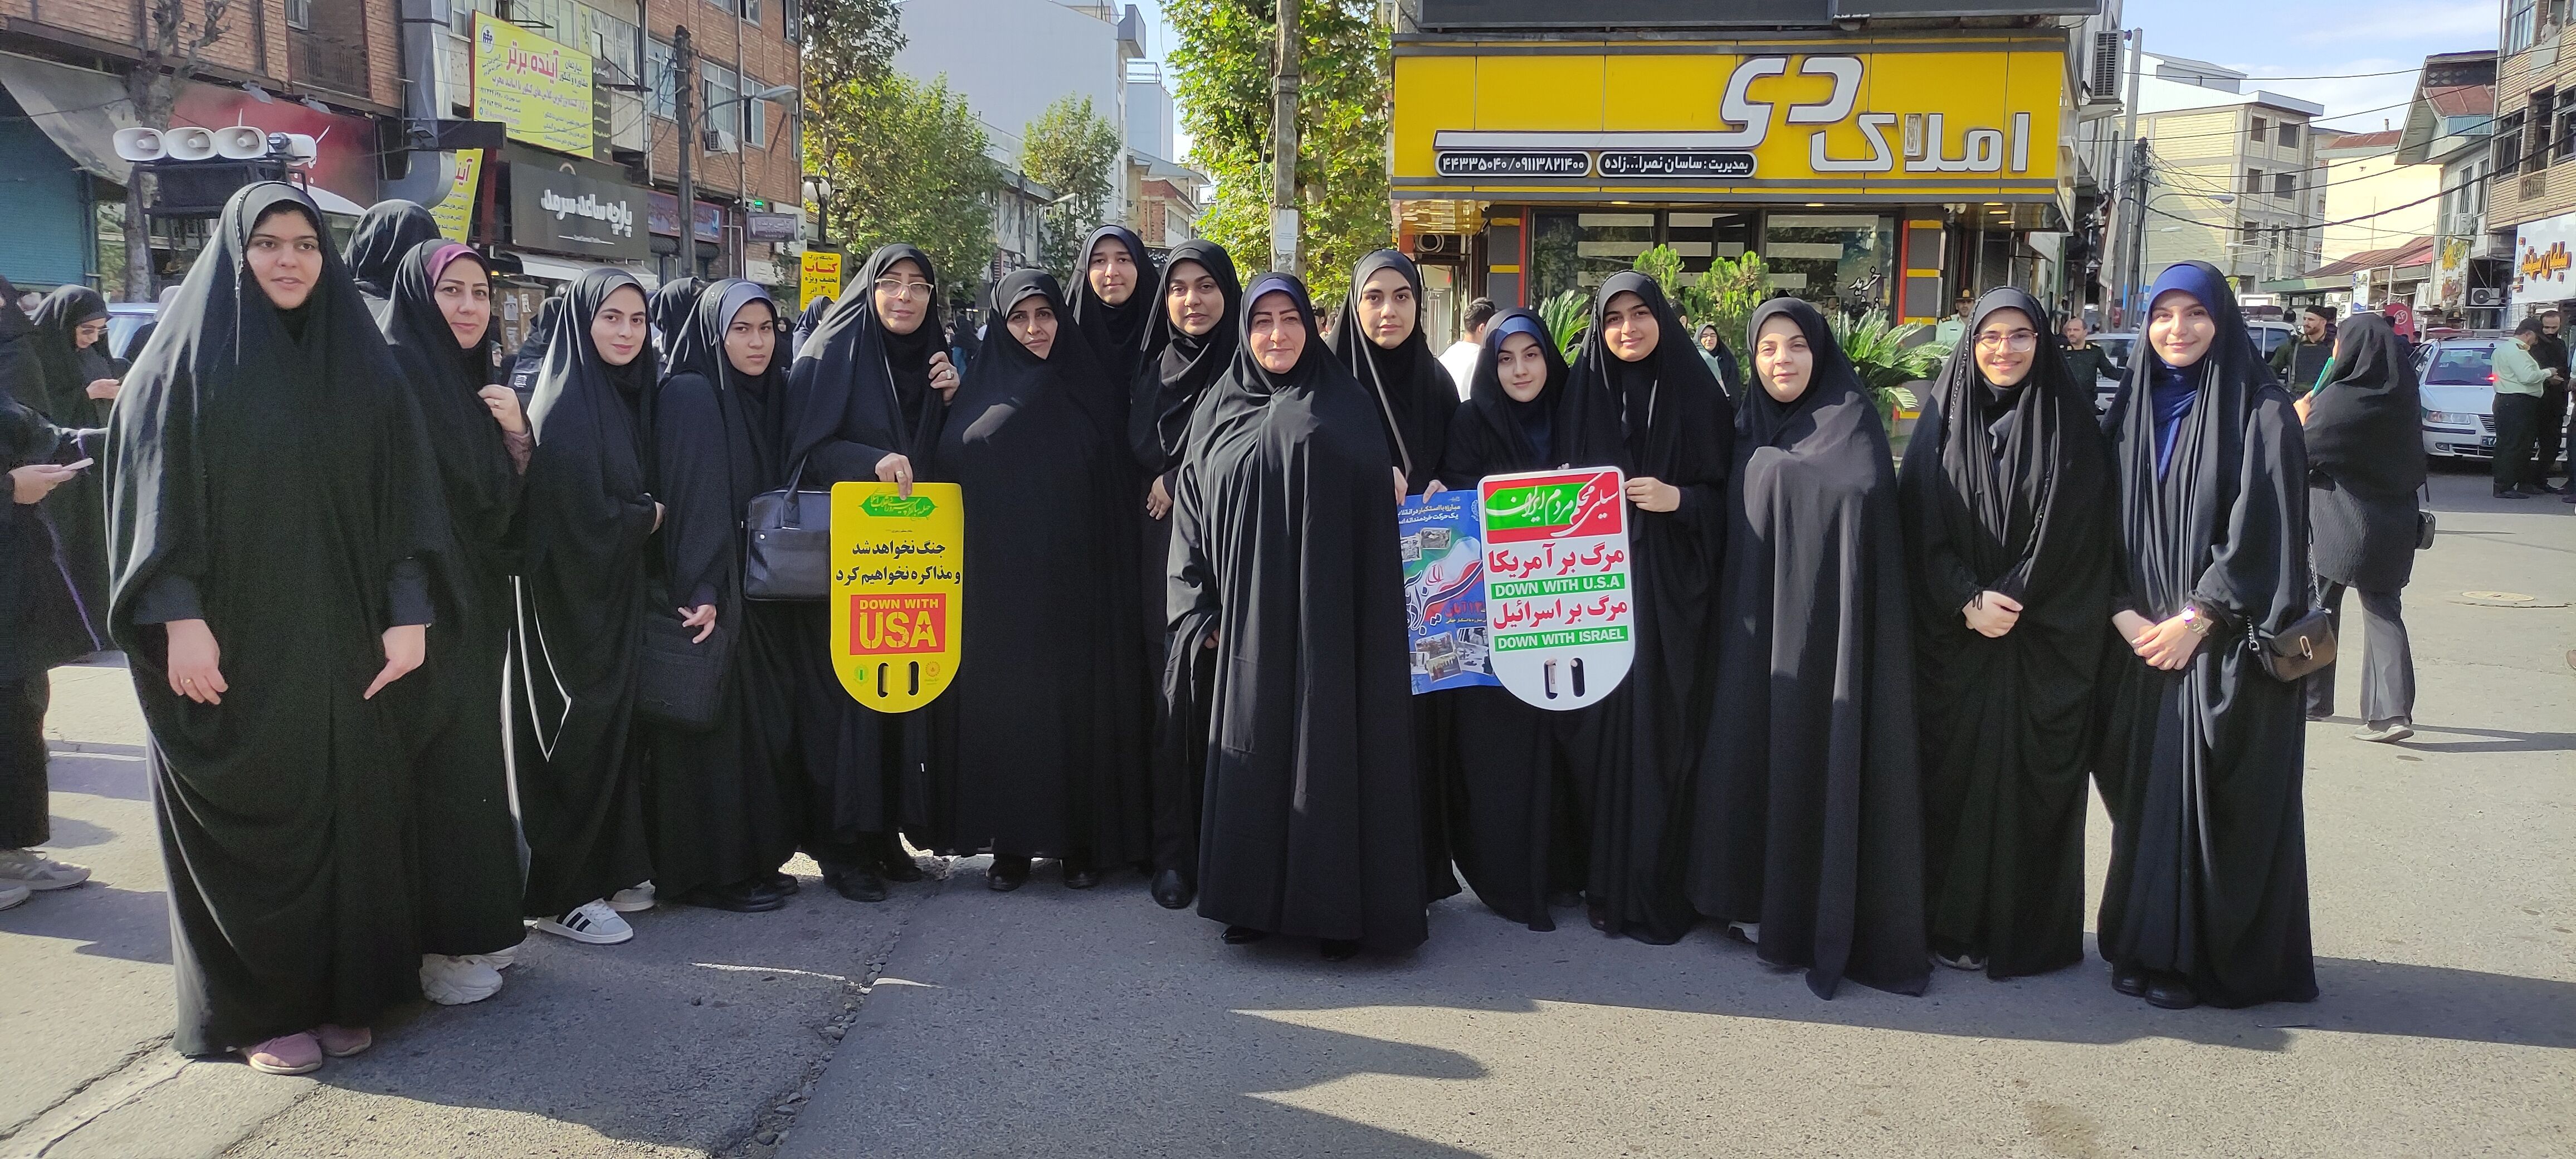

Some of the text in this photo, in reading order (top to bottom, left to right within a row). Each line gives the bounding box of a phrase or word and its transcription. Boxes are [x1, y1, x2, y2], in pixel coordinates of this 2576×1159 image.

[506, 41, 527, 75] برتر
[531, 50, 559, 84] آینده
[1433, 55, 1864, 150] دی
[455, 158, 474, 186] آین
[1664, 156, 1702, 173] ساسان
[540, 188, 575, 221] سرمد
[577, 193, 606, 221] ساعد
[606, 201, 633, 238] پارچه
[804, 272, 818, 284] ویژه
[805, 261, 838, 273] کتاب
[1848, 266, 1881, 296] خرید
[1418, 505, 1441, 514] استکبار
[1433, 513, 1449, 522] حرکت
[1486, 485, 1545, 523] ایران
[1545, 489, 1574, 526] مردم
[1550, 489, 1618, 537] سیلی
[852, 539, 945, 559] جنگ نخواهد شد
[1488, 542, 1624, 579] مرگ بر آمریکا
[836, 565, 960, 586] و مذاکره نخواهیم کرد
[1495, 575, 1620, 597] DOWN WITH U.S.A
[860, 598, 939, 610] DOWN WITH
[1493, 595, 1627, 630] مرگ بر اسرائیل
[859, 611, 938, 649] USA
[1498, 629, 1624, 649] DOWN WITH ISRAEL
